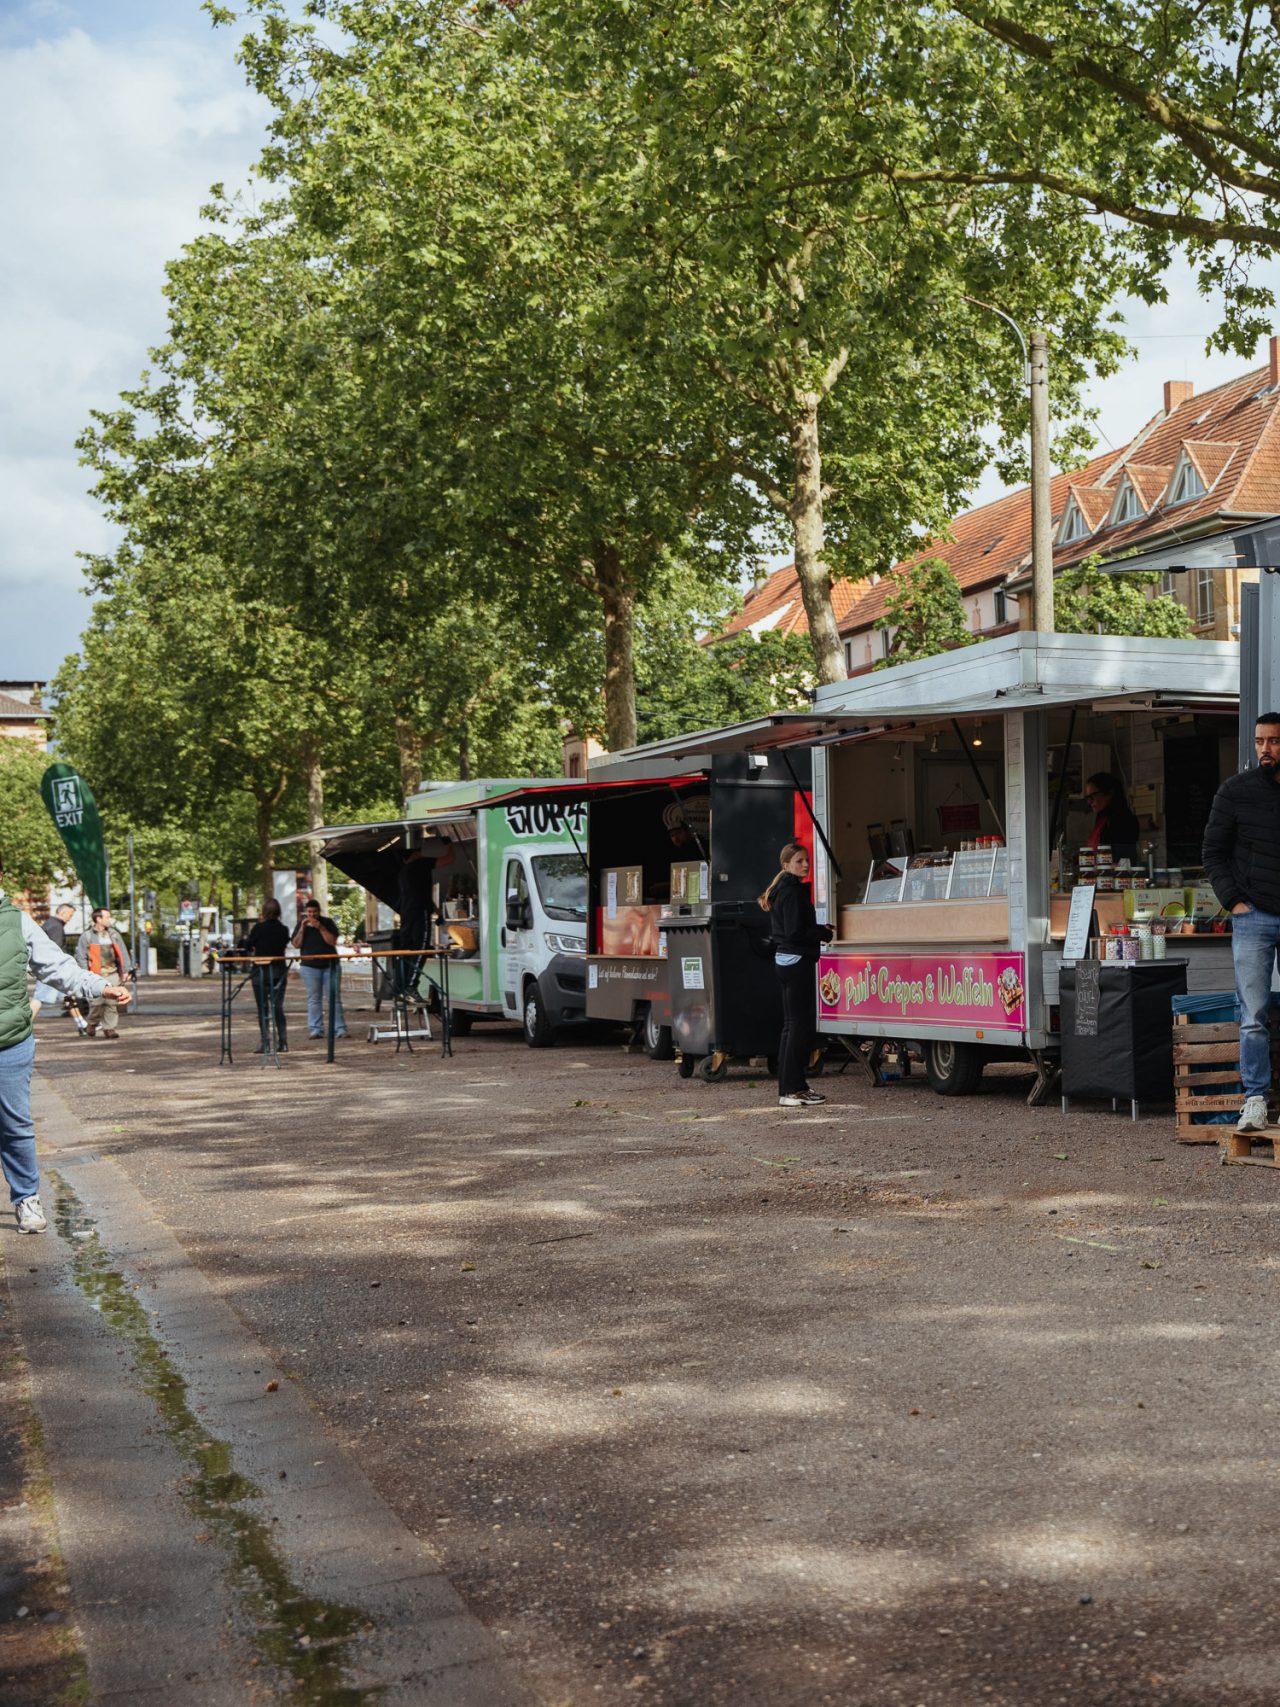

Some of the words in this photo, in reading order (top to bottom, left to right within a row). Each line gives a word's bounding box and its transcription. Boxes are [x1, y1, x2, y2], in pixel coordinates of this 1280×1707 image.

[55, 810, 84, 828] EXIT
[925, 973, 935, 1002] &
[937, 964, 994, 1007] Waffeln
